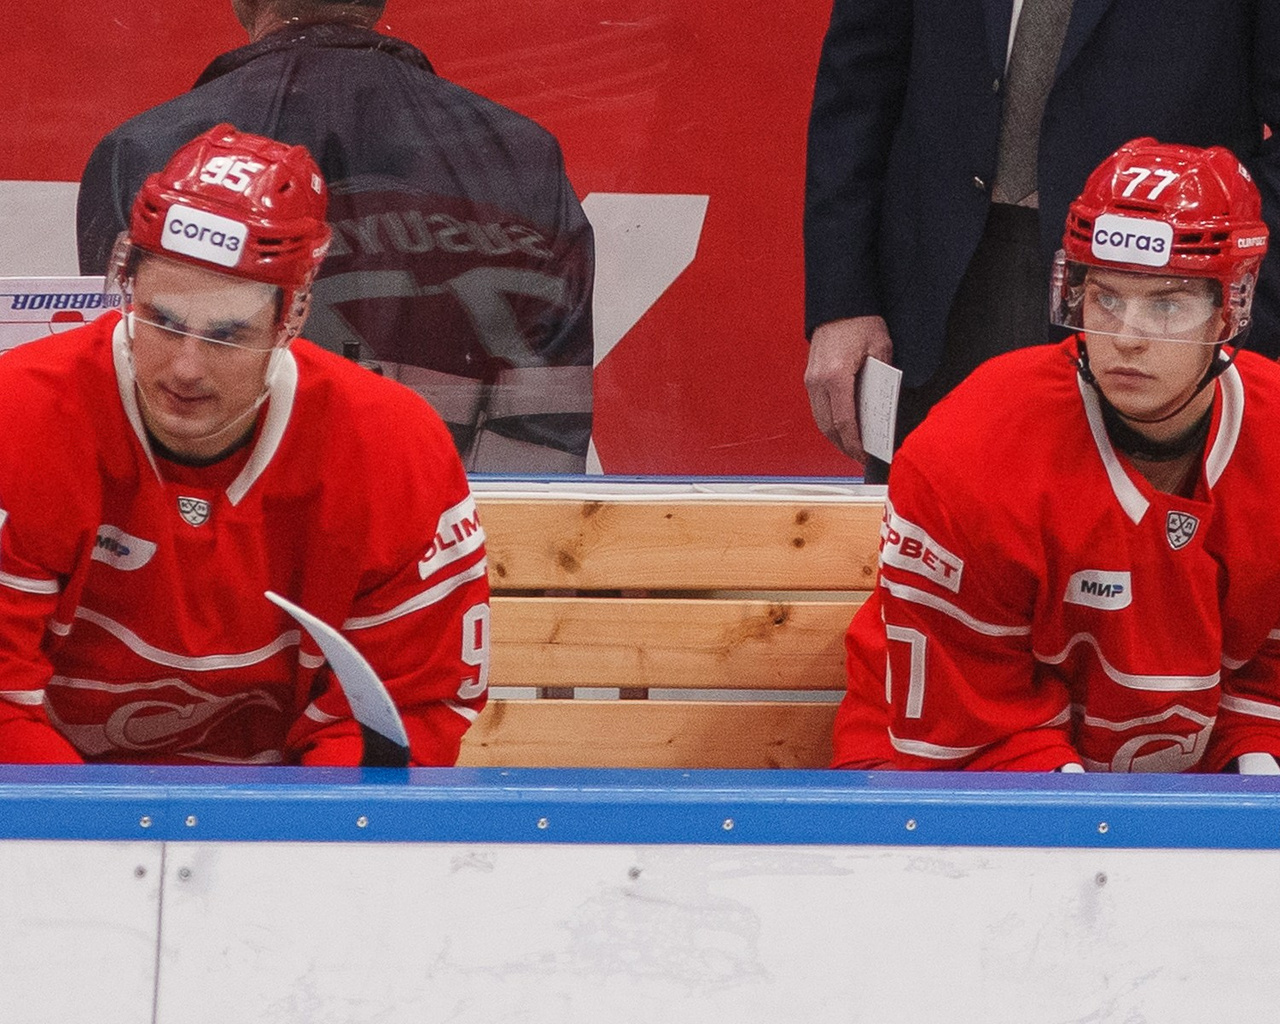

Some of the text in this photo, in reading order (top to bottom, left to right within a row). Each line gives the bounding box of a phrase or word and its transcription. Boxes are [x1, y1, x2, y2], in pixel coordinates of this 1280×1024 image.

[200, 156, 266, 192] 95
[1121, 166, 1181, 200] 77
[169, 219, 240, 252] согаз
[1094, 229, 1166, 254] согаз
[11, 293, 120, 310] ARRIOR
[885, 527, 959, 579] PBET
[1080, 579, 1124, 598] МИР
[456, 602, 491, 700] 9
